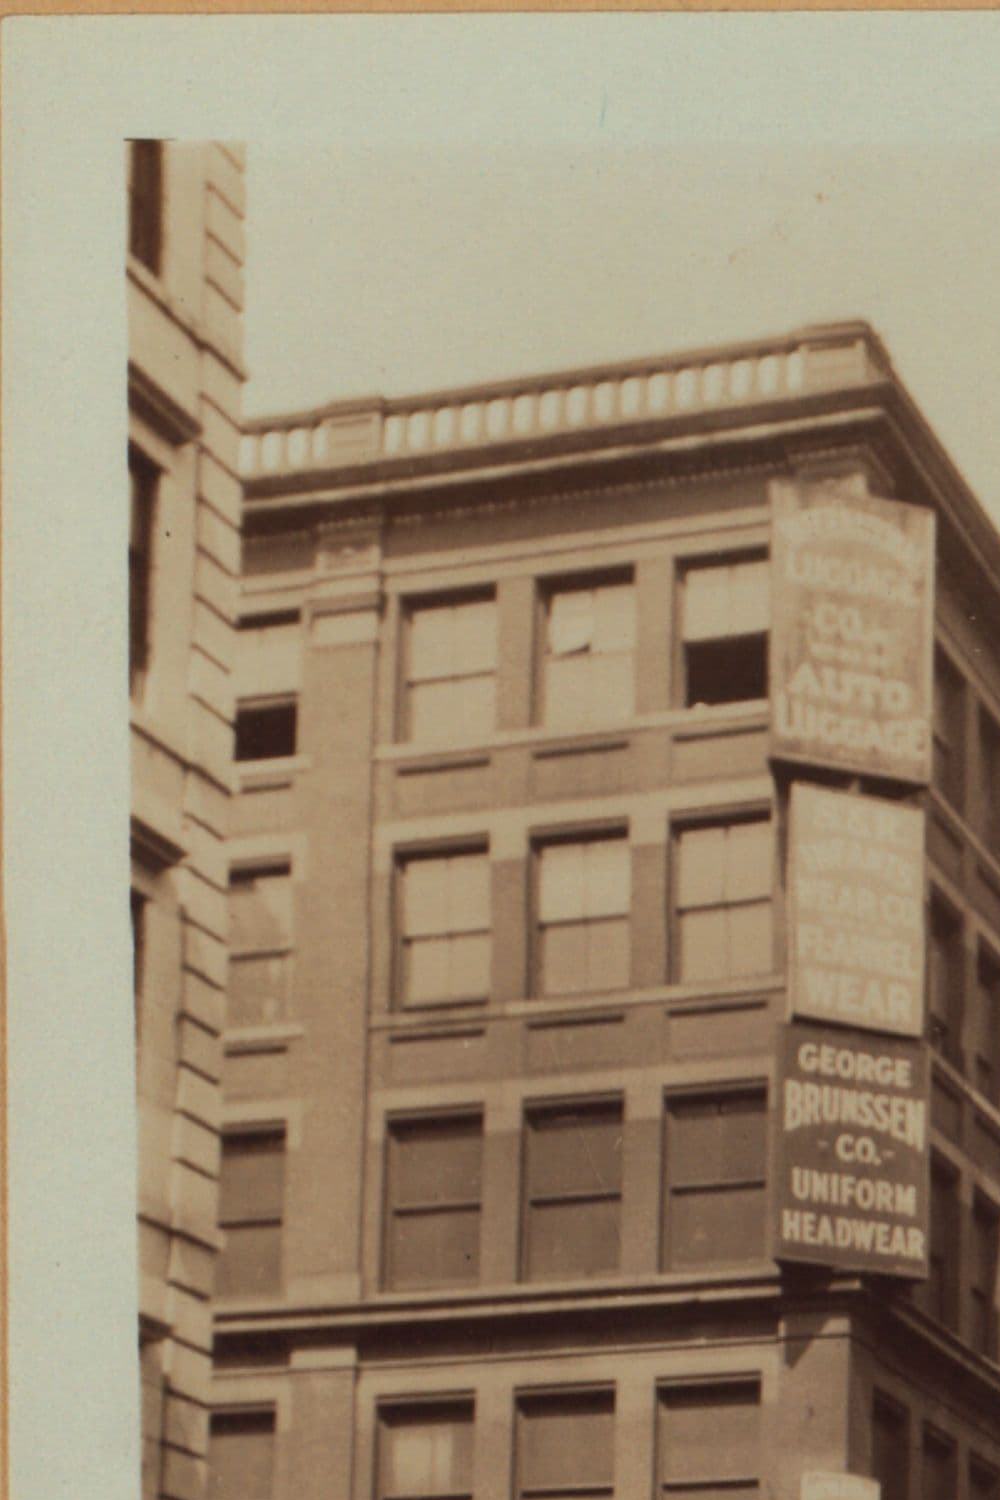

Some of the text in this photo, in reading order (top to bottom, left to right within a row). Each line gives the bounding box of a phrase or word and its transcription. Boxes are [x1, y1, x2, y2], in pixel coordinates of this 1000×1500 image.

[788, 663, 911, 714] AUTO
[775, 693, 930, 754] LUGGAGE
[797, 877, 877, 920] WEAR
[798, 923, 917, 978] FLANNEL
[803, 967, 913, 1024] WEAR
[797, 1043, 911, 1087] GEORGE
[784, 1079, 925, 1152] BRUNSSEN
[791, 1167, 917, 1217] UNIFORM
[782, 1209, 925, 1260] HEADWEAR
